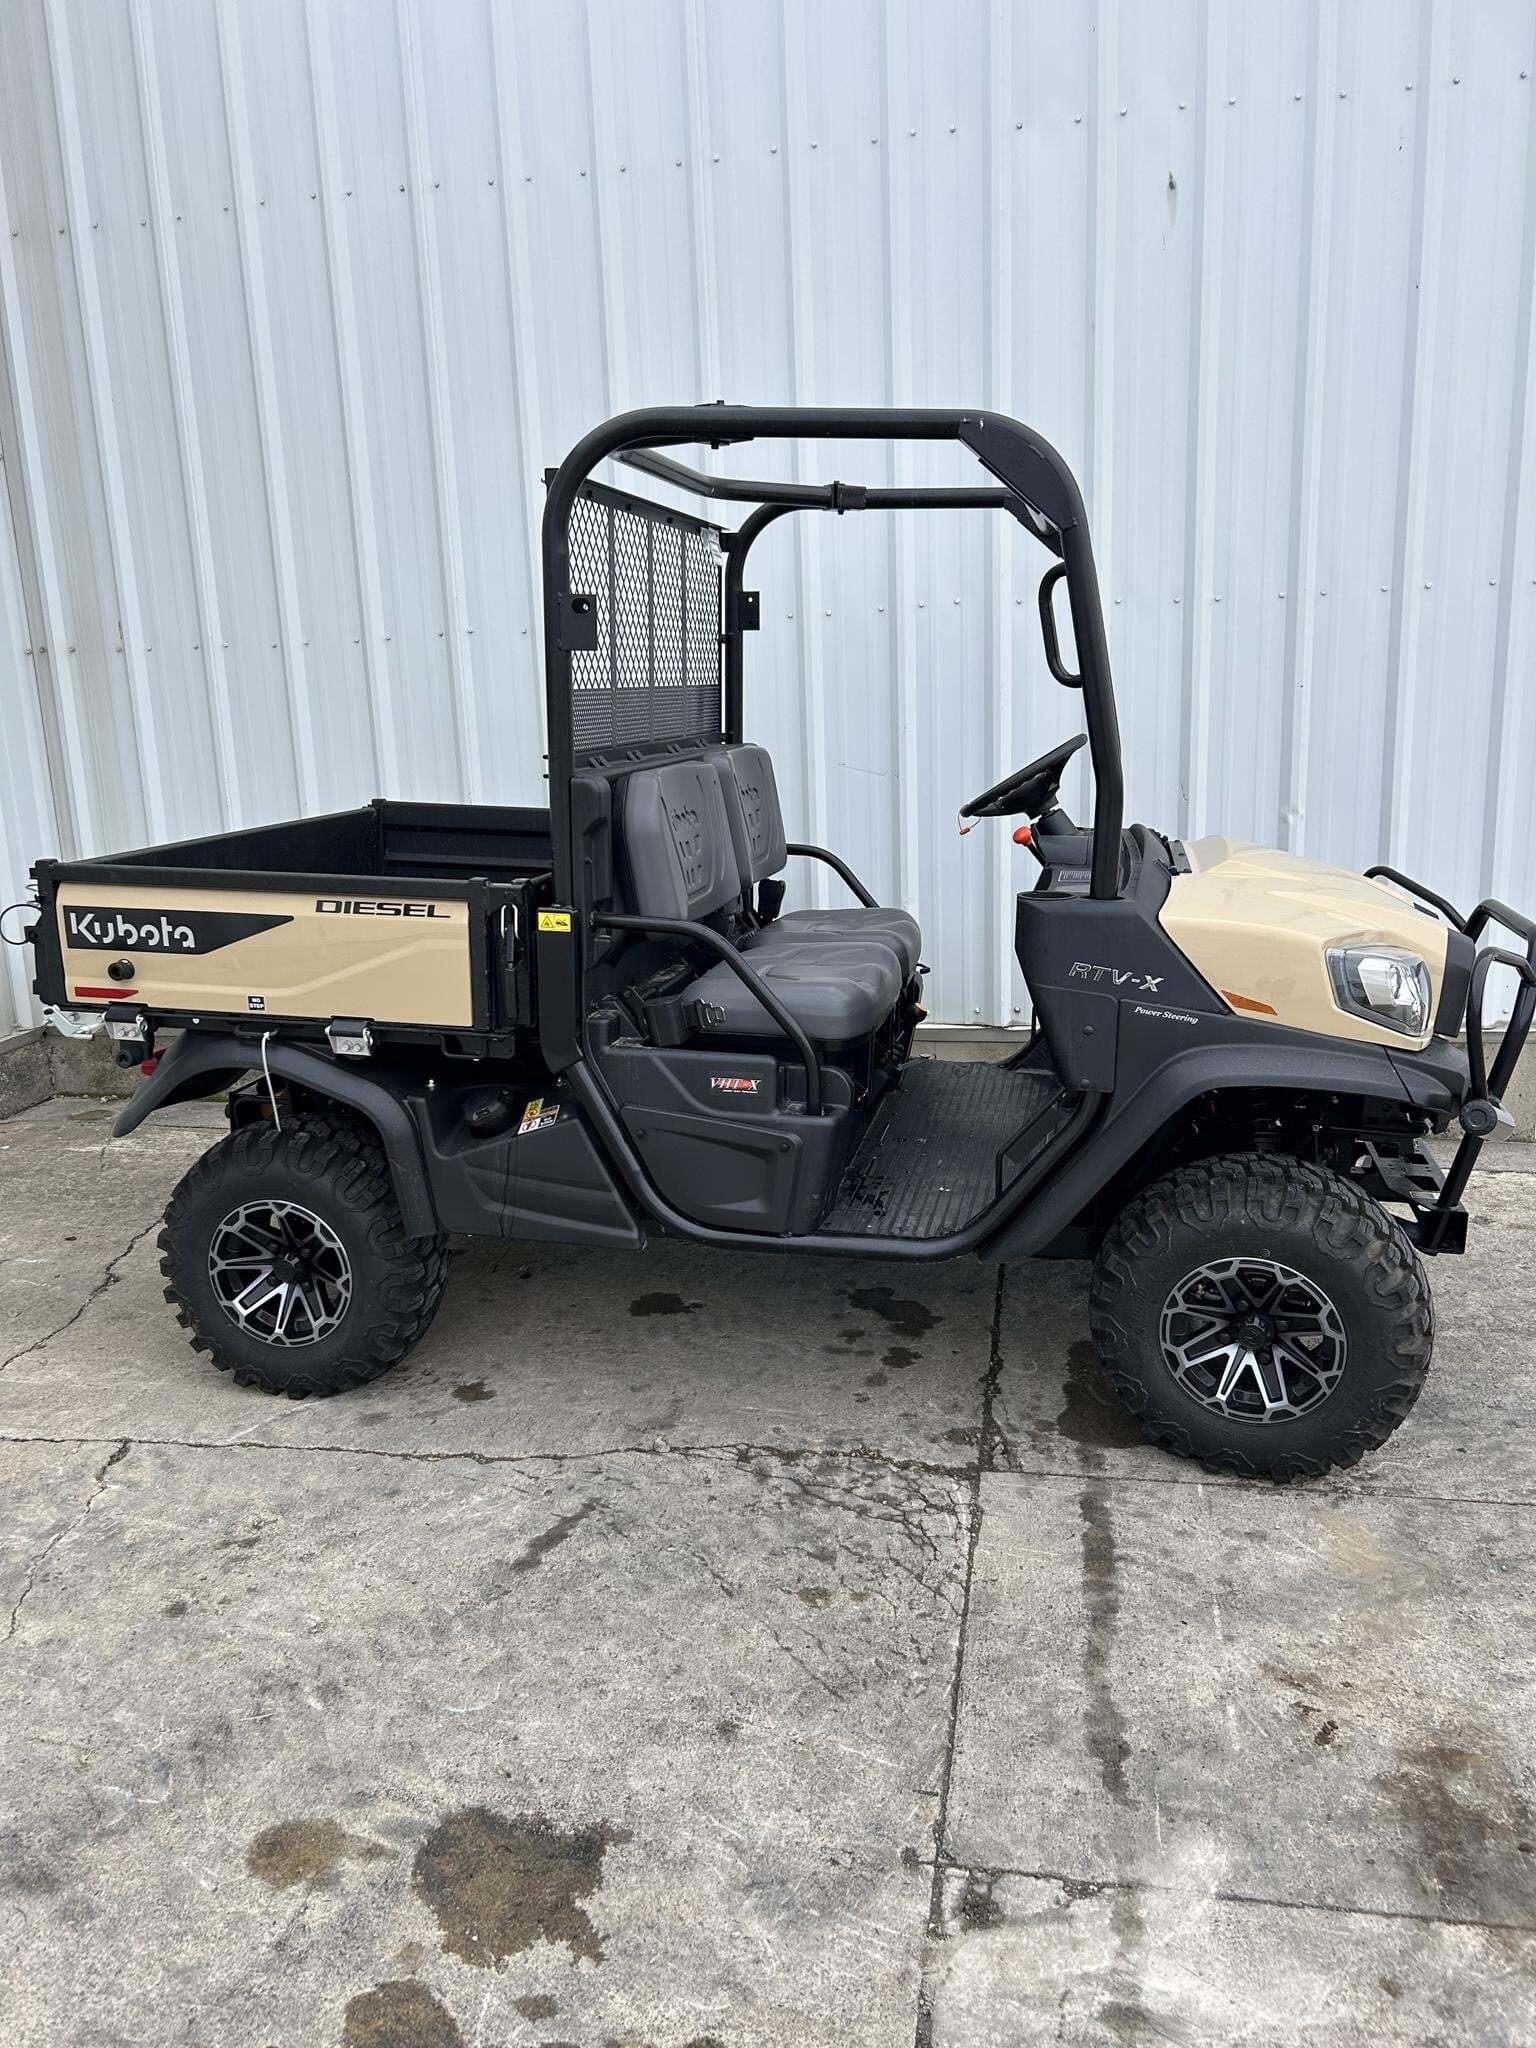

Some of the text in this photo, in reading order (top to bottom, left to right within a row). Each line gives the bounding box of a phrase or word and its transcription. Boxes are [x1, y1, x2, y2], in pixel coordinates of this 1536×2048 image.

[315, 899, 451, 919] DIESEL
[69, 911, 196, 949] Kubota
[1068, 961, 1164, 992] RTV-X
[1134, 1006, 1199, 1025] Power Steering
